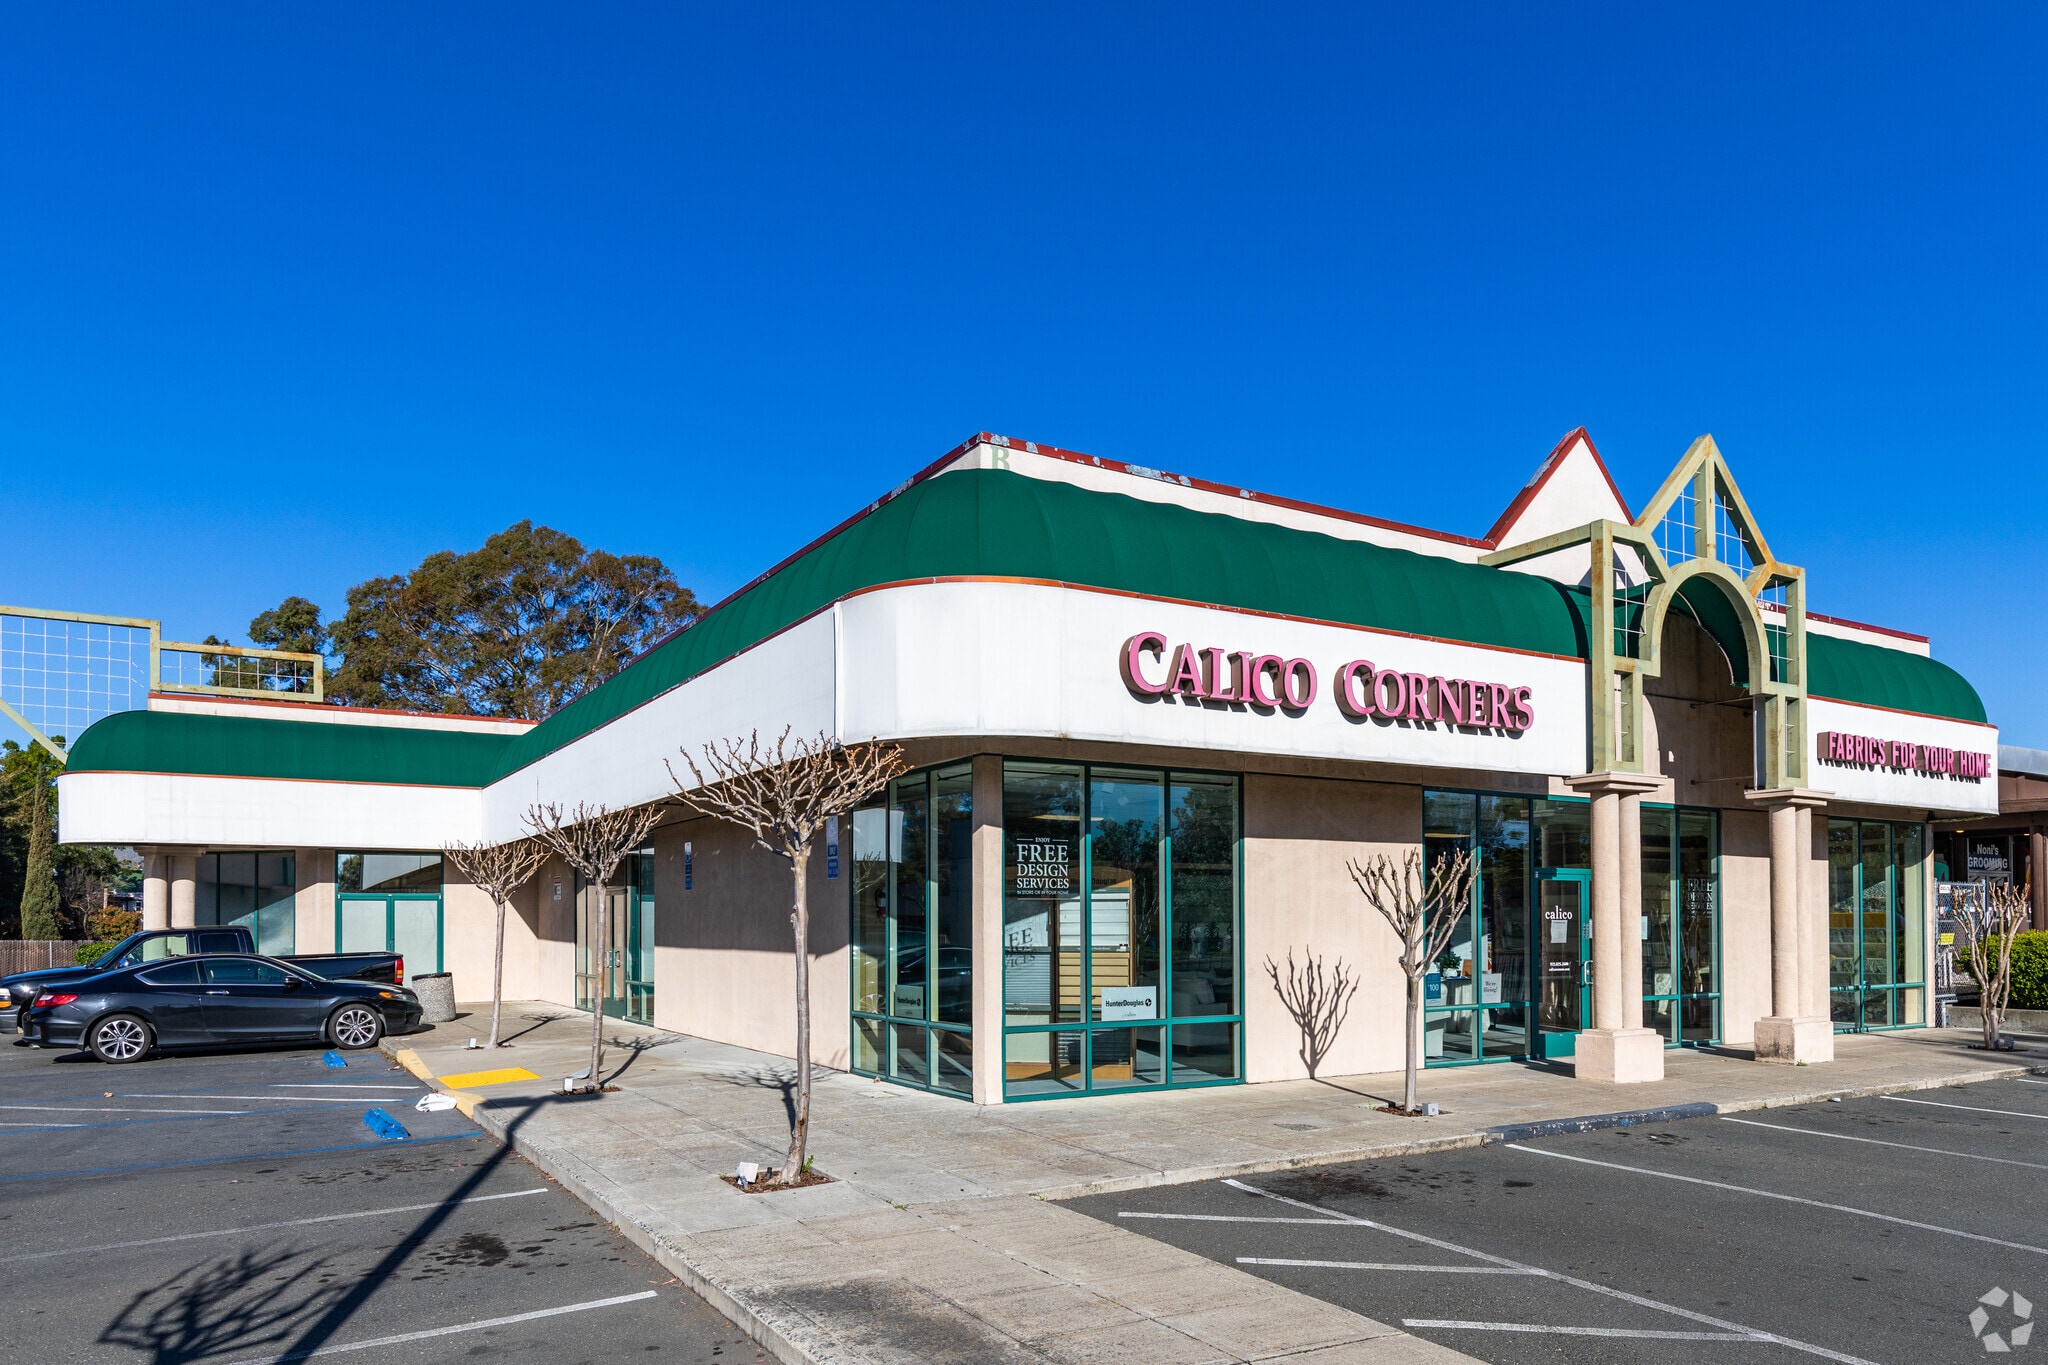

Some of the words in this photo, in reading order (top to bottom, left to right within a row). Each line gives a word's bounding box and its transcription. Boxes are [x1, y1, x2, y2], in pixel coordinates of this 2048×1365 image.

[1121, 631, 1318, 710] CALICO
[1335, 659, 1535, 732] CORNERS
[1826, 731, 1887, 765] FABRICS
[1890, 740, 1918, 769] FOR
[1922, 745, 1955, 774] YOUR
[1960, 751, 1992, 778] HOME
[1016, 844, 1069, 862] FREE
[1976, 844, 1999, 855] Noni's
[1968, 856, 2008, 869] GROOMING
[1016, 863, 1069, 877] DESIGN
[1016, 877, 1070, 889] SERVICES
[1545, 905, 1573, 920] calico
[1105, 999, 1145, 1008] HunterDouglas
